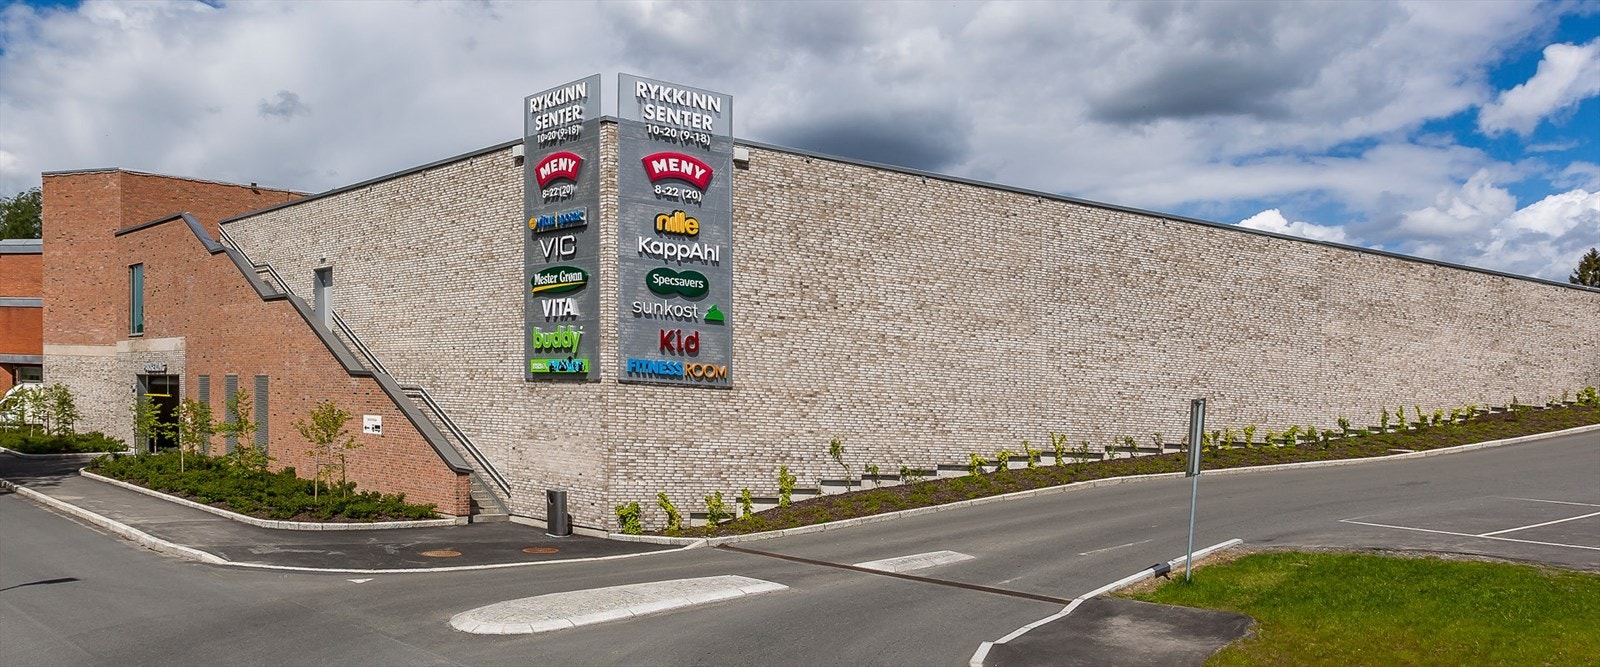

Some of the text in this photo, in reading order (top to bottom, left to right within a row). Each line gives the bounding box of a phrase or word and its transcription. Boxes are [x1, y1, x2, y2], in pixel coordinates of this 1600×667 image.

[530, 82, 587, 113] RYKKINN
[635, 81, 721, 113] RYKKINN
[535, 105, 581, 131] SENTER
[644, 104, 713, 131] SENTER
[537, 124, 579, 143] 10-20 (9-18)
[646, 125, 711, 146] 10-20 (9-18)
[540, 157, 576, 179] MENY
[651, 158, 706, 180] MENY
[542, 184, 574, 198] 8-22 (20)
[654, 185, 702, 201] 8-22 (20)
[657, 211, 700, 235] nille
[540, 235, 575, 258] VIC
[638, 236, 720, 262] KappAhl
[534, 270, 583, 286] Mester Grønn
[652, 273, 704, 289] Specsavers
[542, 298, 576, 317] VITA
[632, 300, 699, 319] sunkost
[533, 325, 581, 353] buddy
[659, 328, 700, 351] Kid
